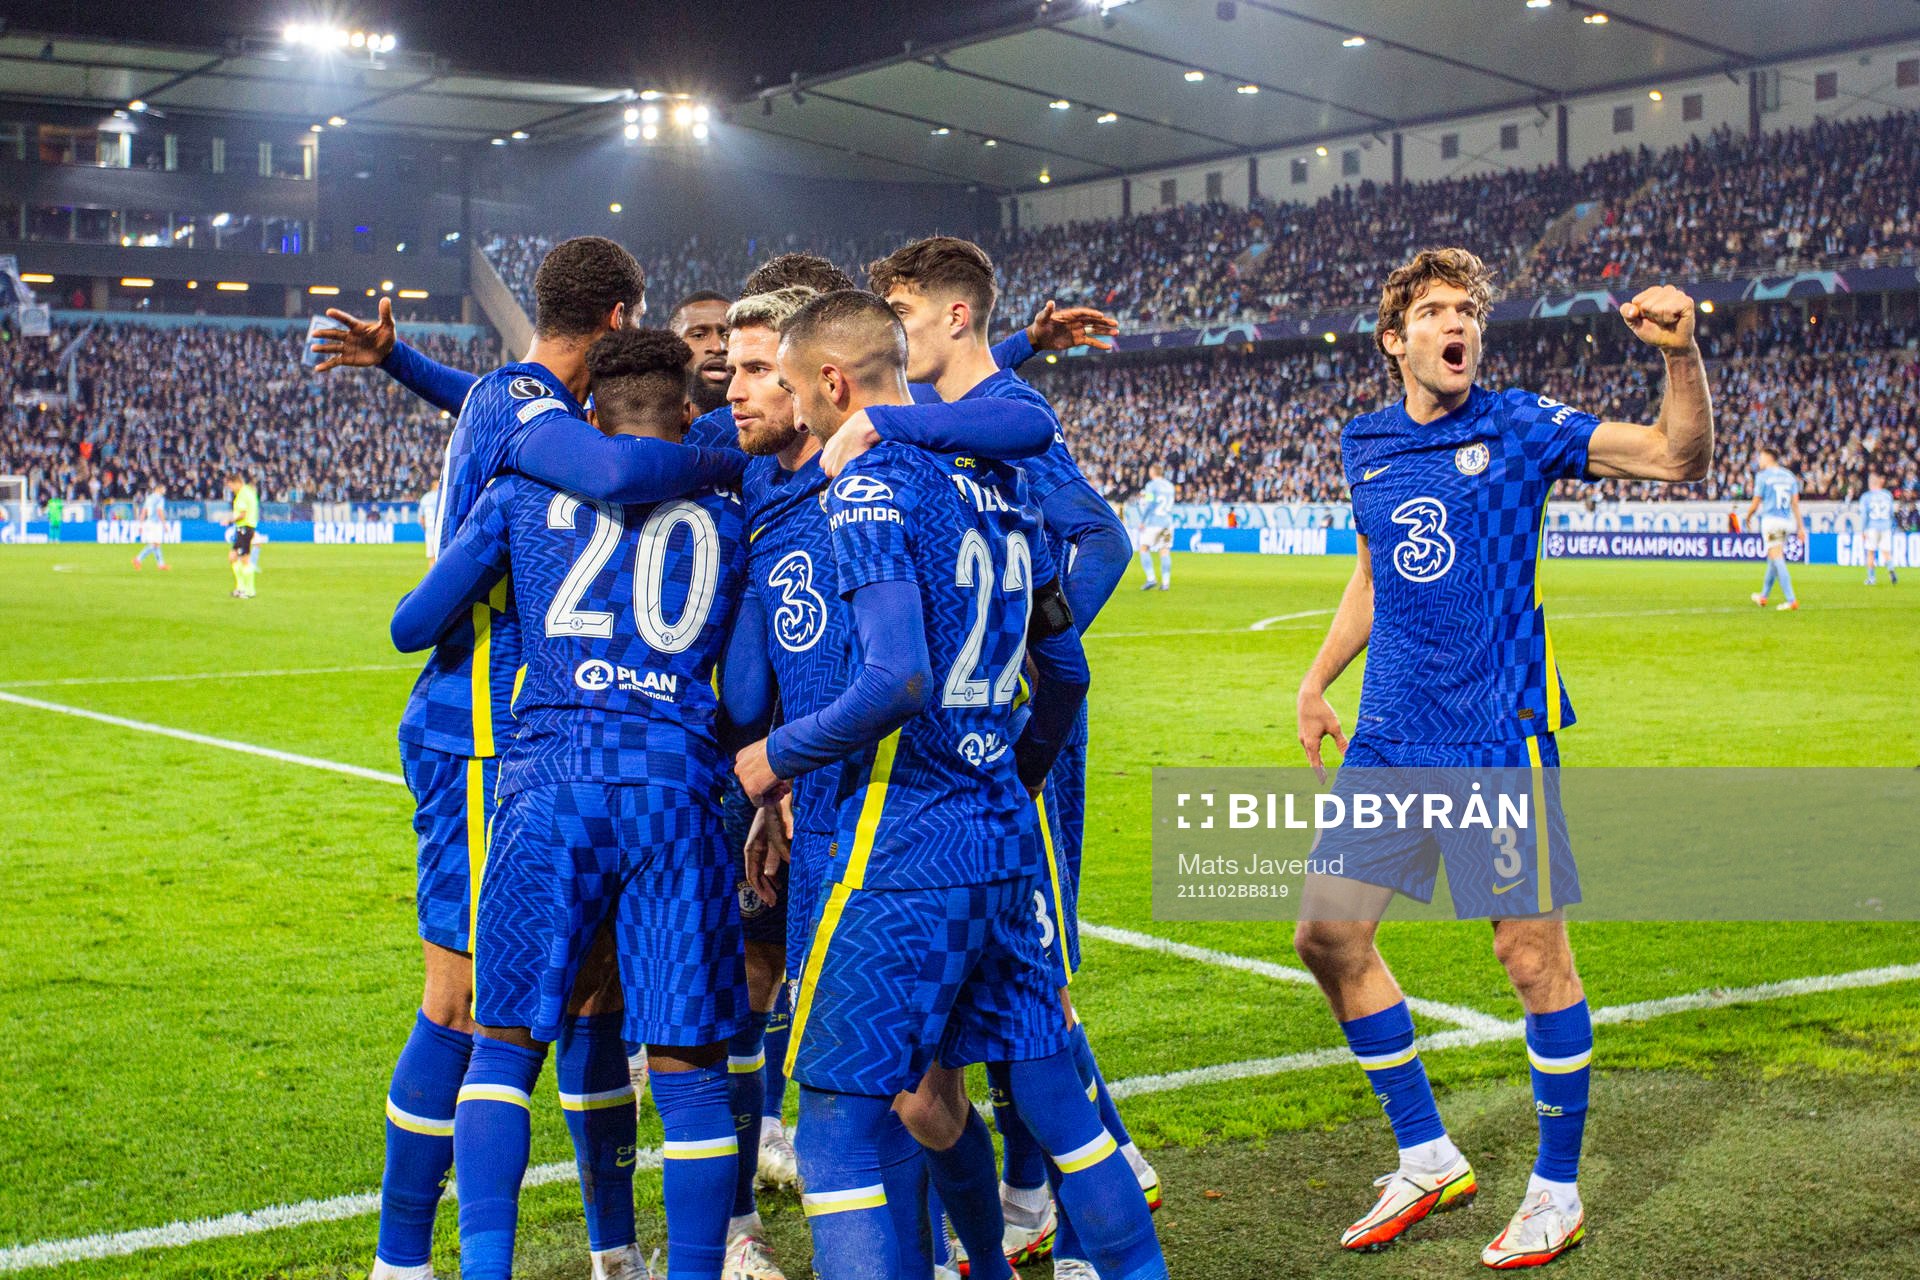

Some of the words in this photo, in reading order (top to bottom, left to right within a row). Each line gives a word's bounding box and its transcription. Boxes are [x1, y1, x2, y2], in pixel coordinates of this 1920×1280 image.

[96, 520, 182, 543] GAZPM
[313, 521, 394, 544] GAZPROM
[829, 506, 904, 532] HYUNDAI
[1259, 528, 1327, 555] GAZPROM
[1391, 497, 1456, 583] 3
[1567, 535, 1608, 555] UEFA
[1611, 536, 1708, 557] CHAMPIONS
[1712, 537, 1768, 558] LEAGU
[545, 488, 720, 654] 20
[768, 550, 828, 652] 3
[942, 528, 1033, 708] 22
[617, 666, 677, 693] PLAN
[1491, 825, 1523, 879] 3
